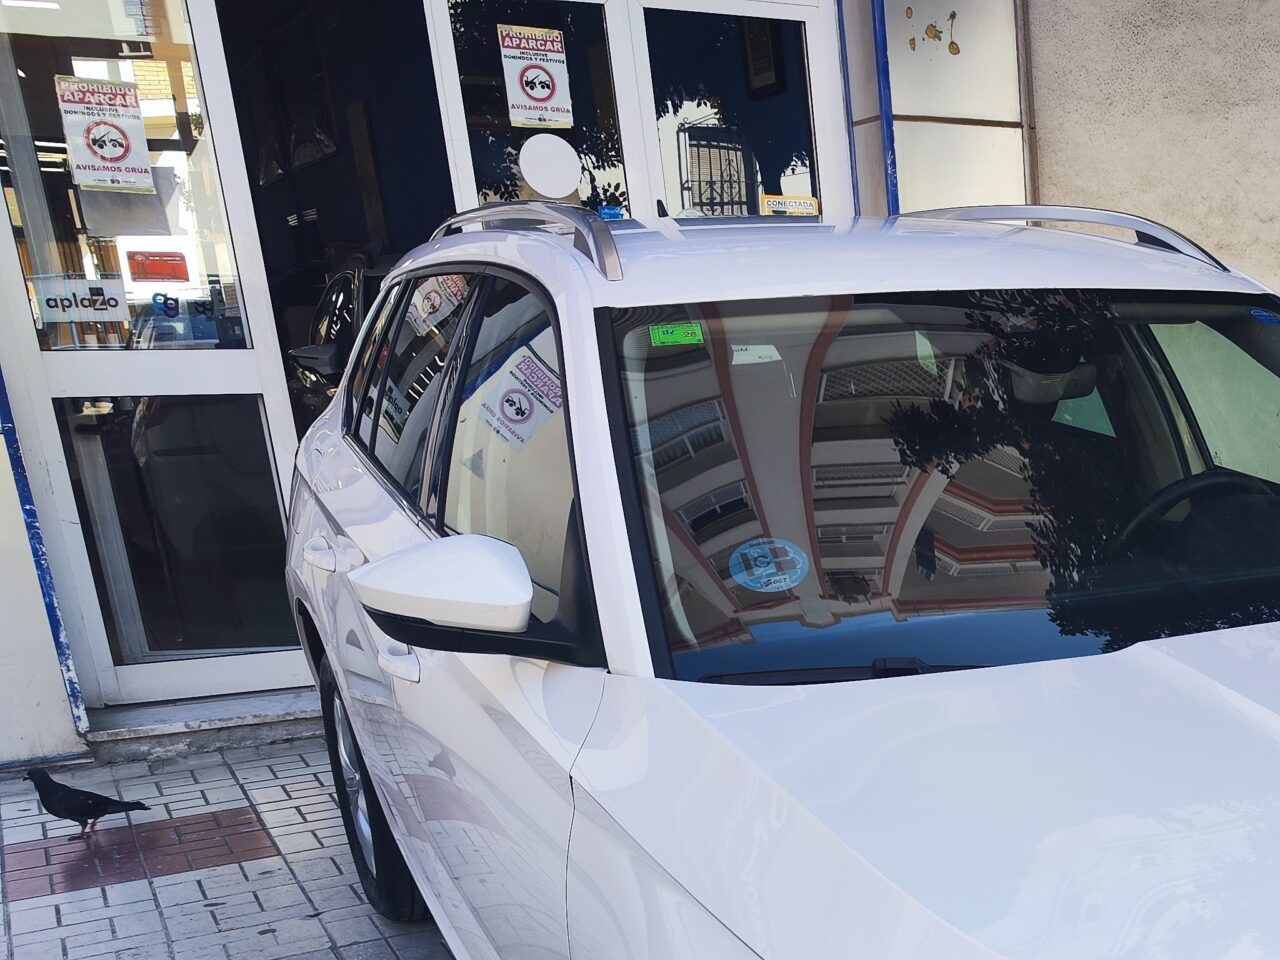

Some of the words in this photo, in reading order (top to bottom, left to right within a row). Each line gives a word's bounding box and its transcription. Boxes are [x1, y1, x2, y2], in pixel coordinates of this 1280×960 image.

[502, 30, 561, 41] PROHIBIDO
[503, 38, 563, 52] APARCAR
[60, 81, 135, 95] PROHIBIDO
[63, 91, 138, 107] APARCAR
[510, 103, 549, 112] AVISAMOS
[75, 163, 123, 173] AVISAMOS
[766, 200, 814, 208] CONECTADA
